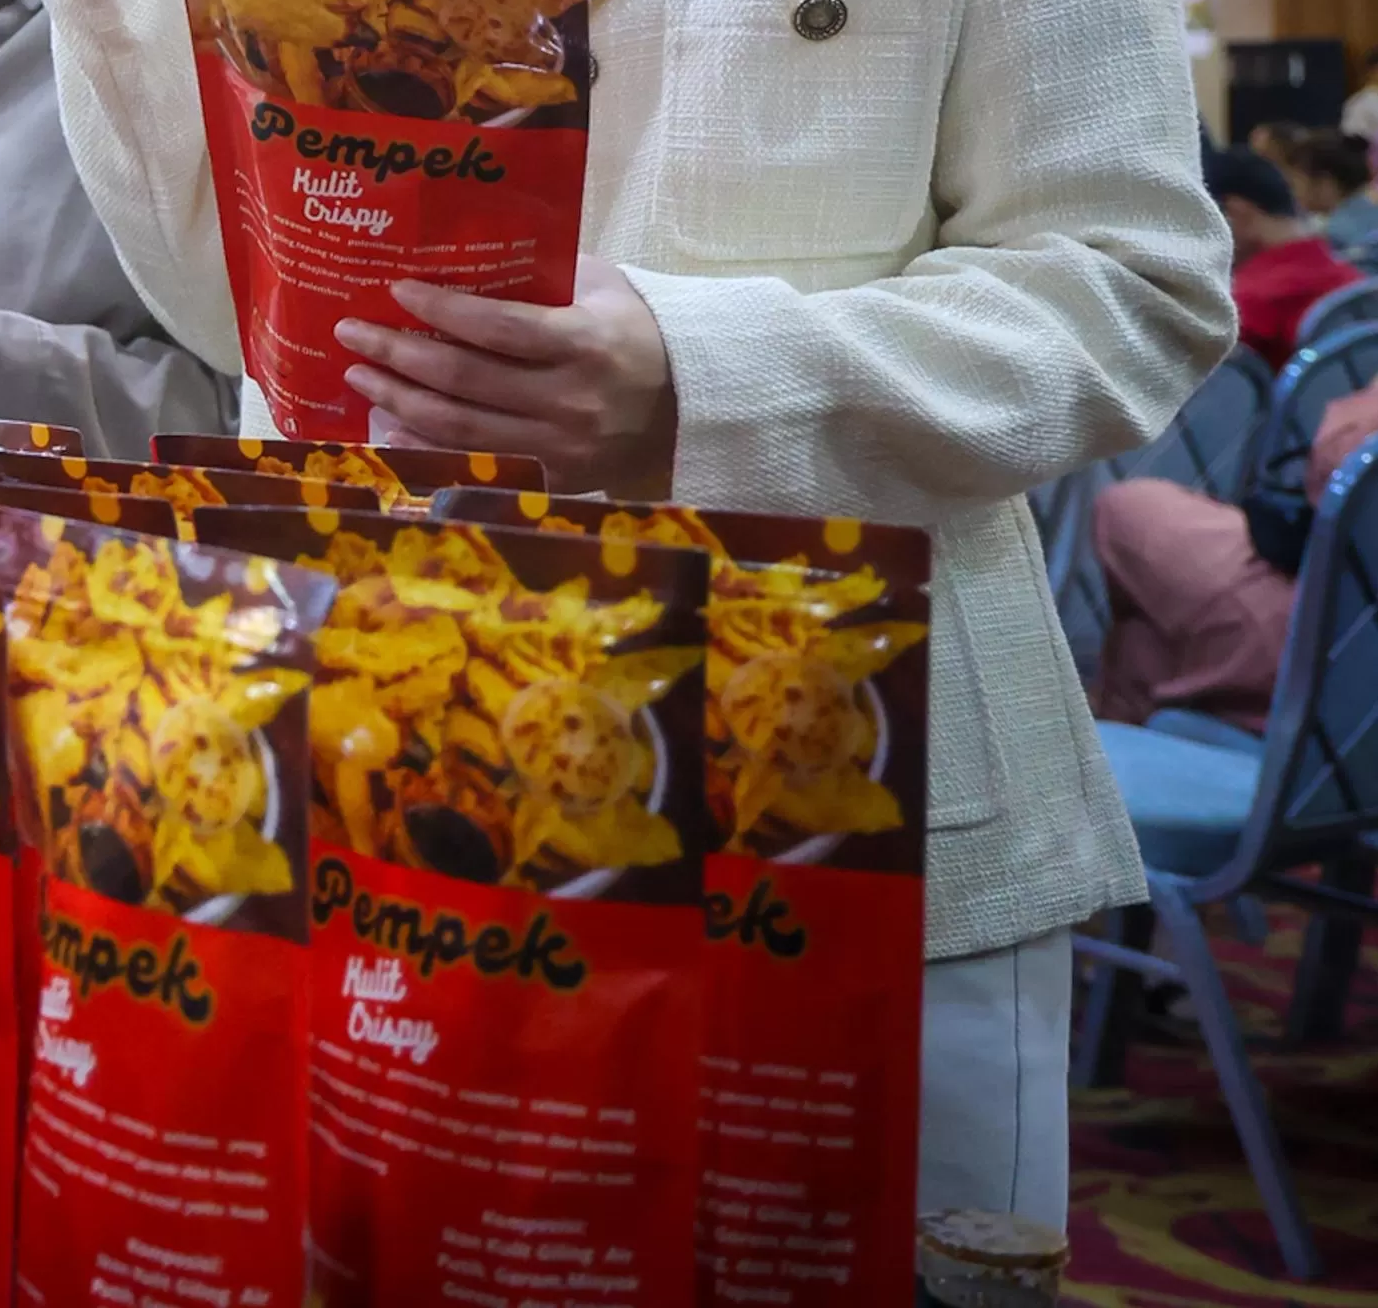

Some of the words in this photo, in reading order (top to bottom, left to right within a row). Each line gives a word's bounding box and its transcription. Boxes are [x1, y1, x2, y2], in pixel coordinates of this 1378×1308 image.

[251, 102, 506, 183] Pempek
[292, 167, 363, 199] Kulit
[303, 195, 394, 237] Crispy
[310, 857, 587, 990] Pempek
[342, 956, 408, 1003] Kulit
